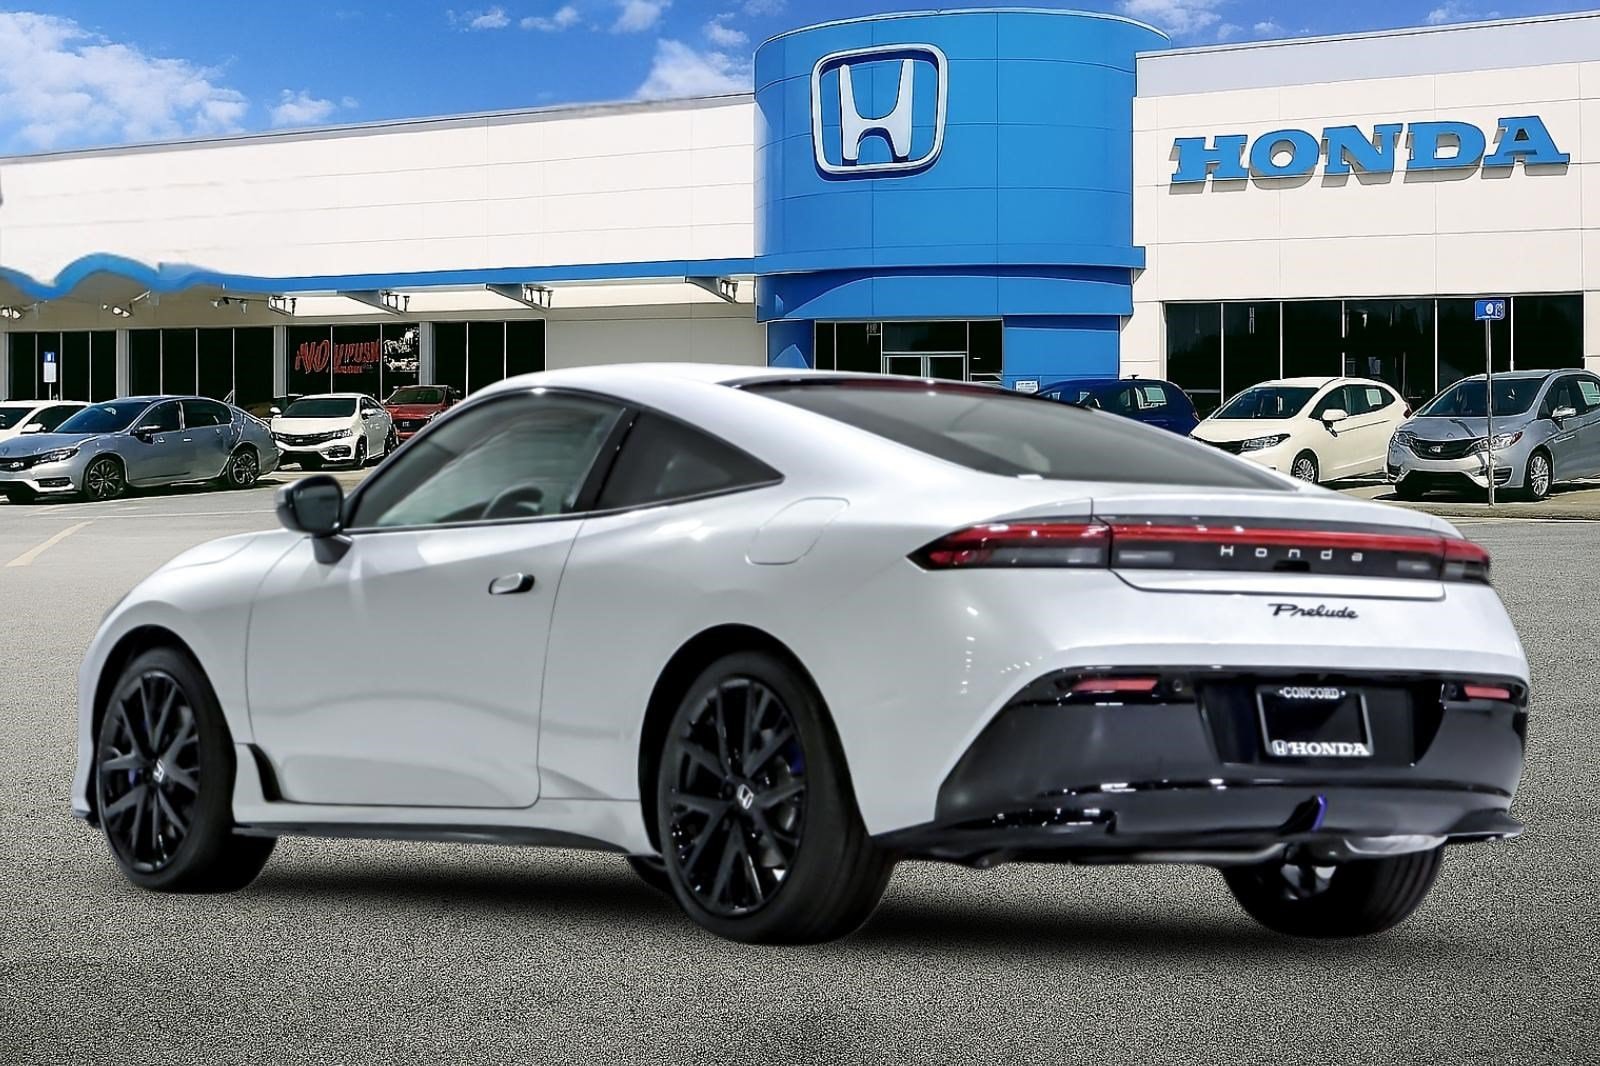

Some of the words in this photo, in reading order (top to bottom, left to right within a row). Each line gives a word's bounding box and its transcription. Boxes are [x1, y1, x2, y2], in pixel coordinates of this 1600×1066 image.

[1171, 115, 1570, 185] HONDA
[1220, 545, 1363, 562] Honda
[1267, 603, 1358, 619] Prelude
[1288, 742, 1371, 757] HONDA
